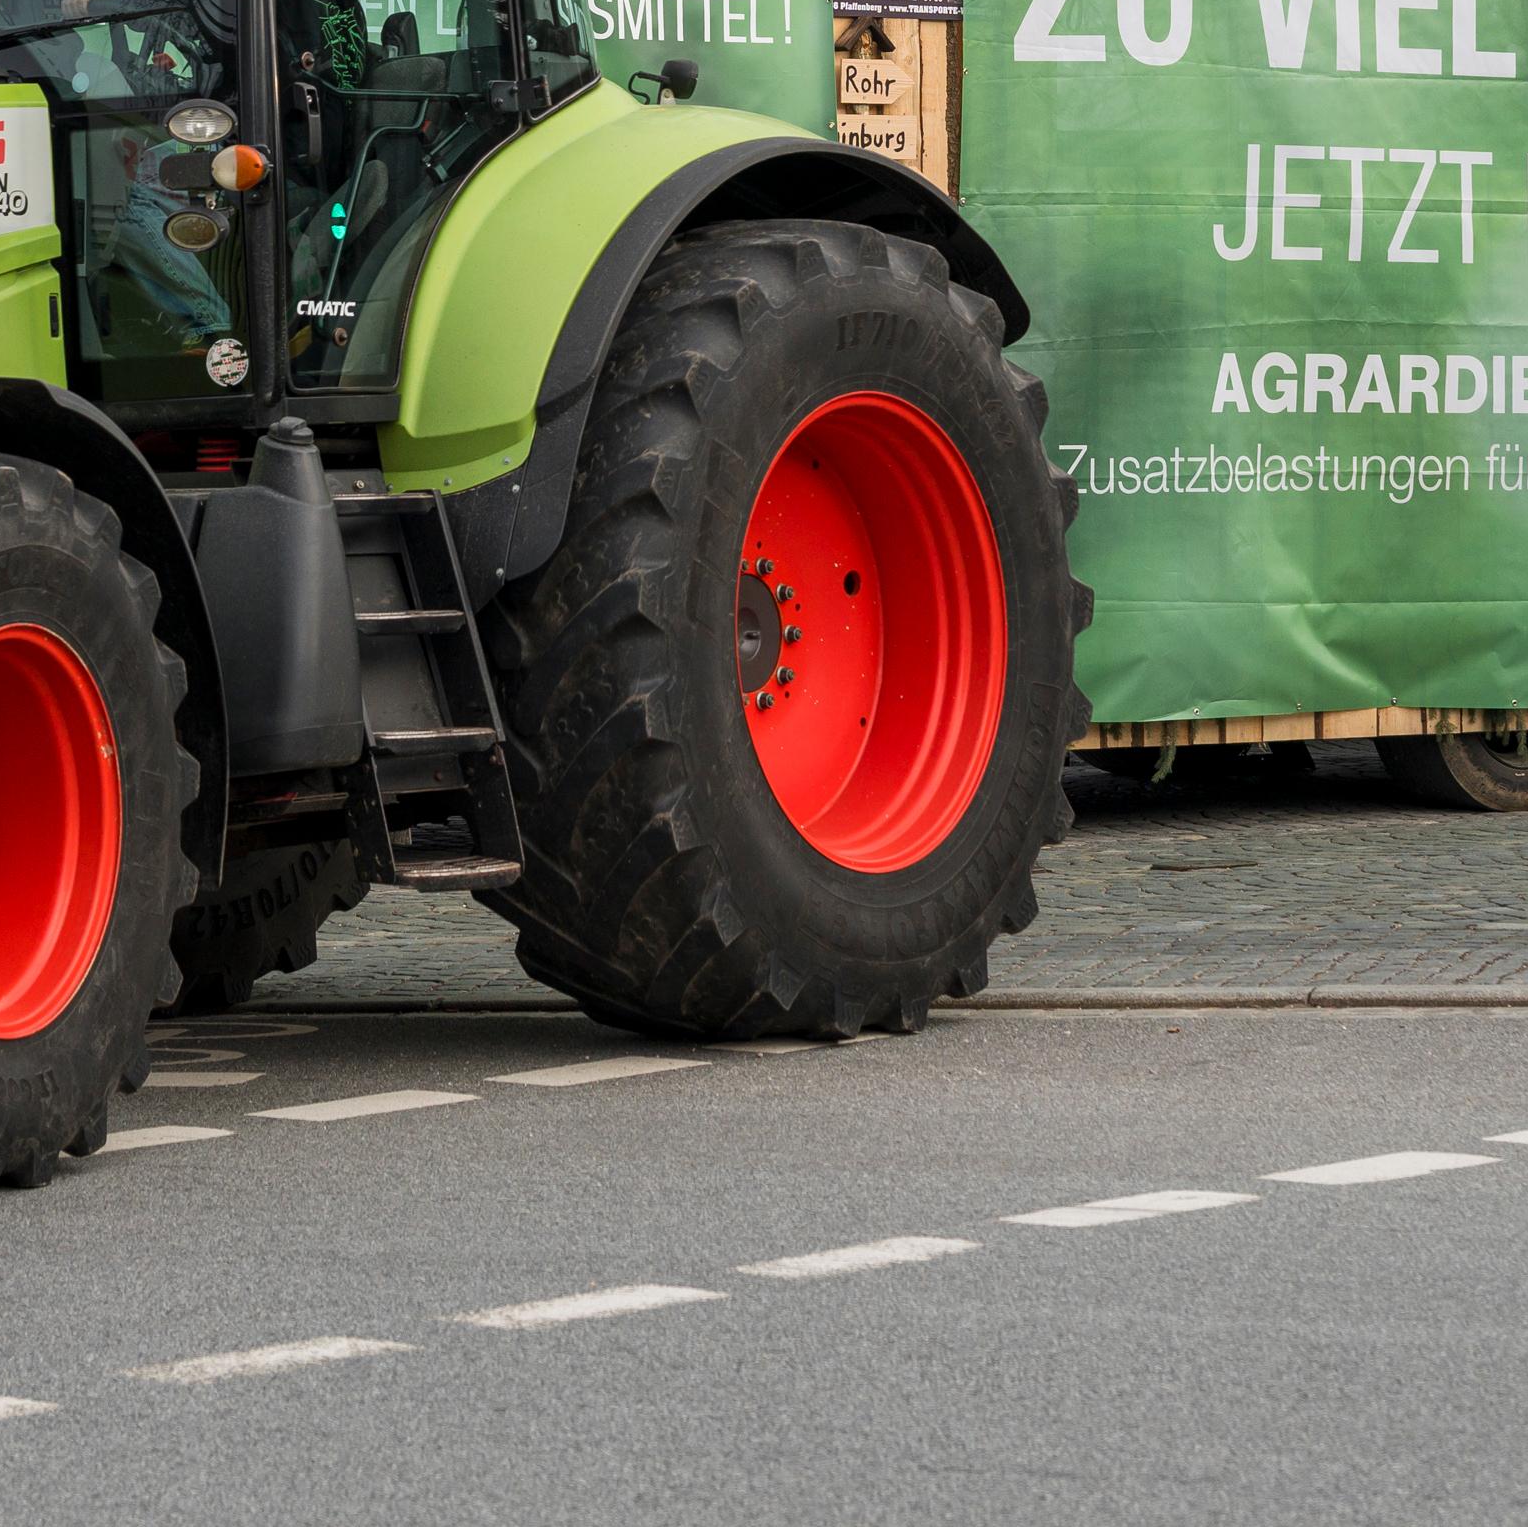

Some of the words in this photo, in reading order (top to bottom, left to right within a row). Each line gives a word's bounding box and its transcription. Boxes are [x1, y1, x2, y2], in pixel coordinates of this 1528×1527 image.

[846, 65, 896, 97] Rohr
[838, 122, 905, 152] inburg
[1212, 143, 1492, 264] JETZT
[297, 300, 356, 316] CMATIC
[1058, 443, 1469, 504] Zusatzbelastungen
